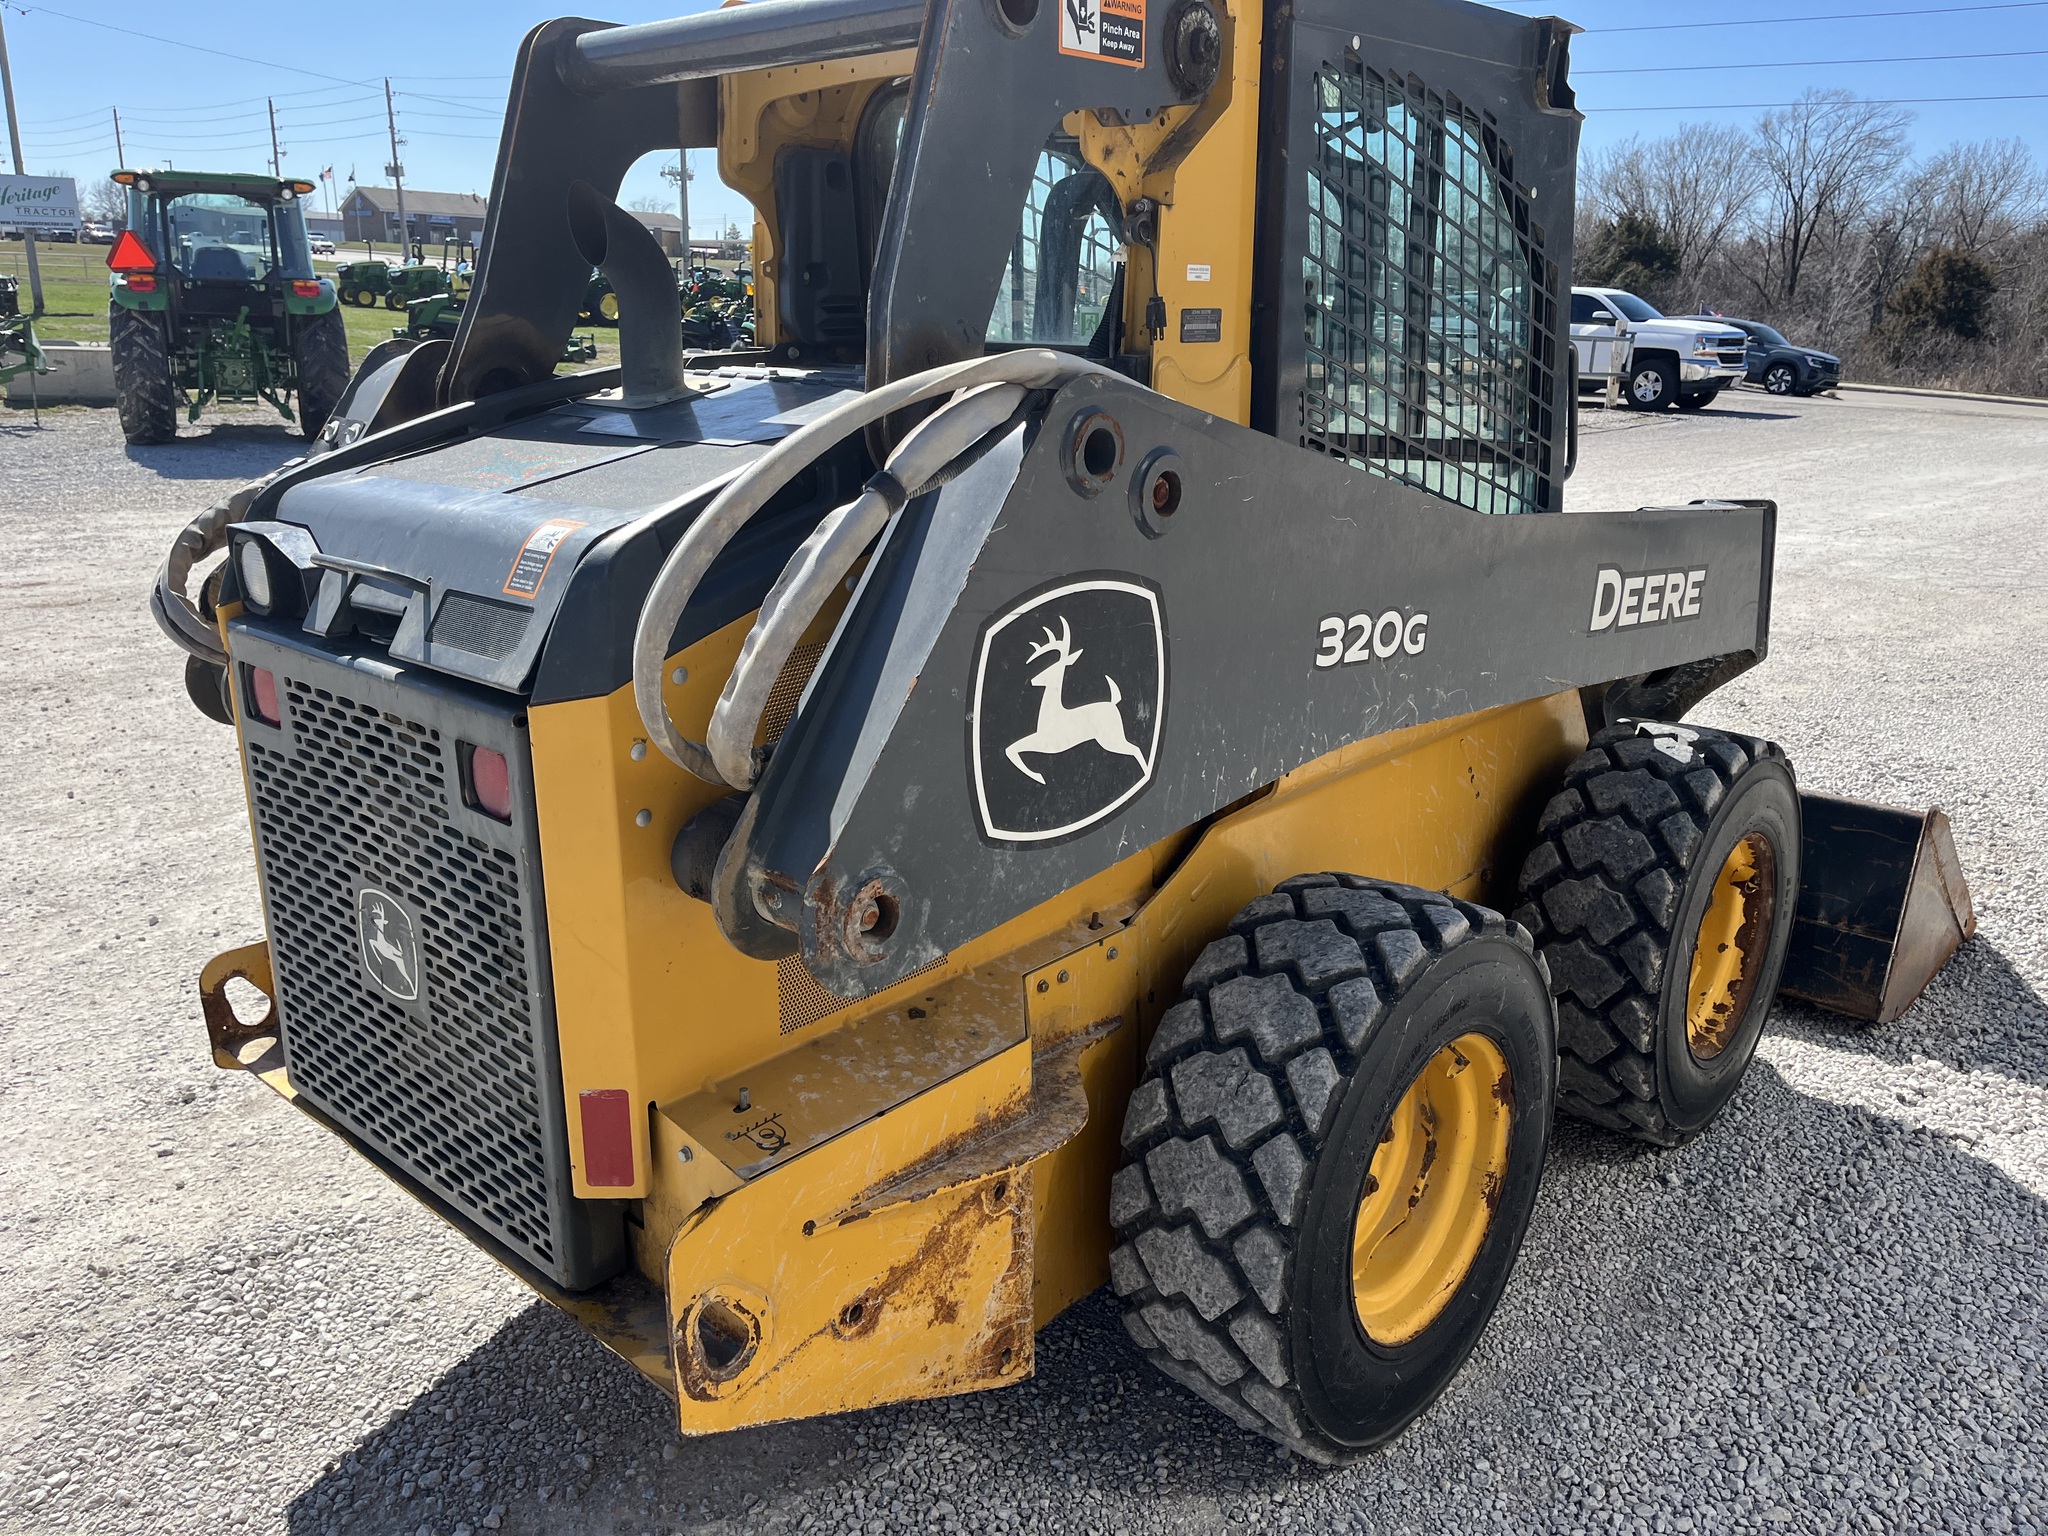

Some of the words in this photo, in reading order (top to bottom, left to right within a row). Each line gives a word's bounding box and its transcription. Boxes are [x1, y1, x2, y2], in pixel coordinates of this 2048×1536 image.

[1110, 0, 1142, 14] WARNING
[1102, 22, 1122, 36] Pinch
[1123, 26, 1140, 39] Area
[1102, 37, 1118, 50] Keep
[1118, 40, 1135, 54] Away
[15, 207, 75, 216] TRACTOR
[1590, 568, 1706, 632] DEERE
[1315, 610, 1428, 668] 320G
